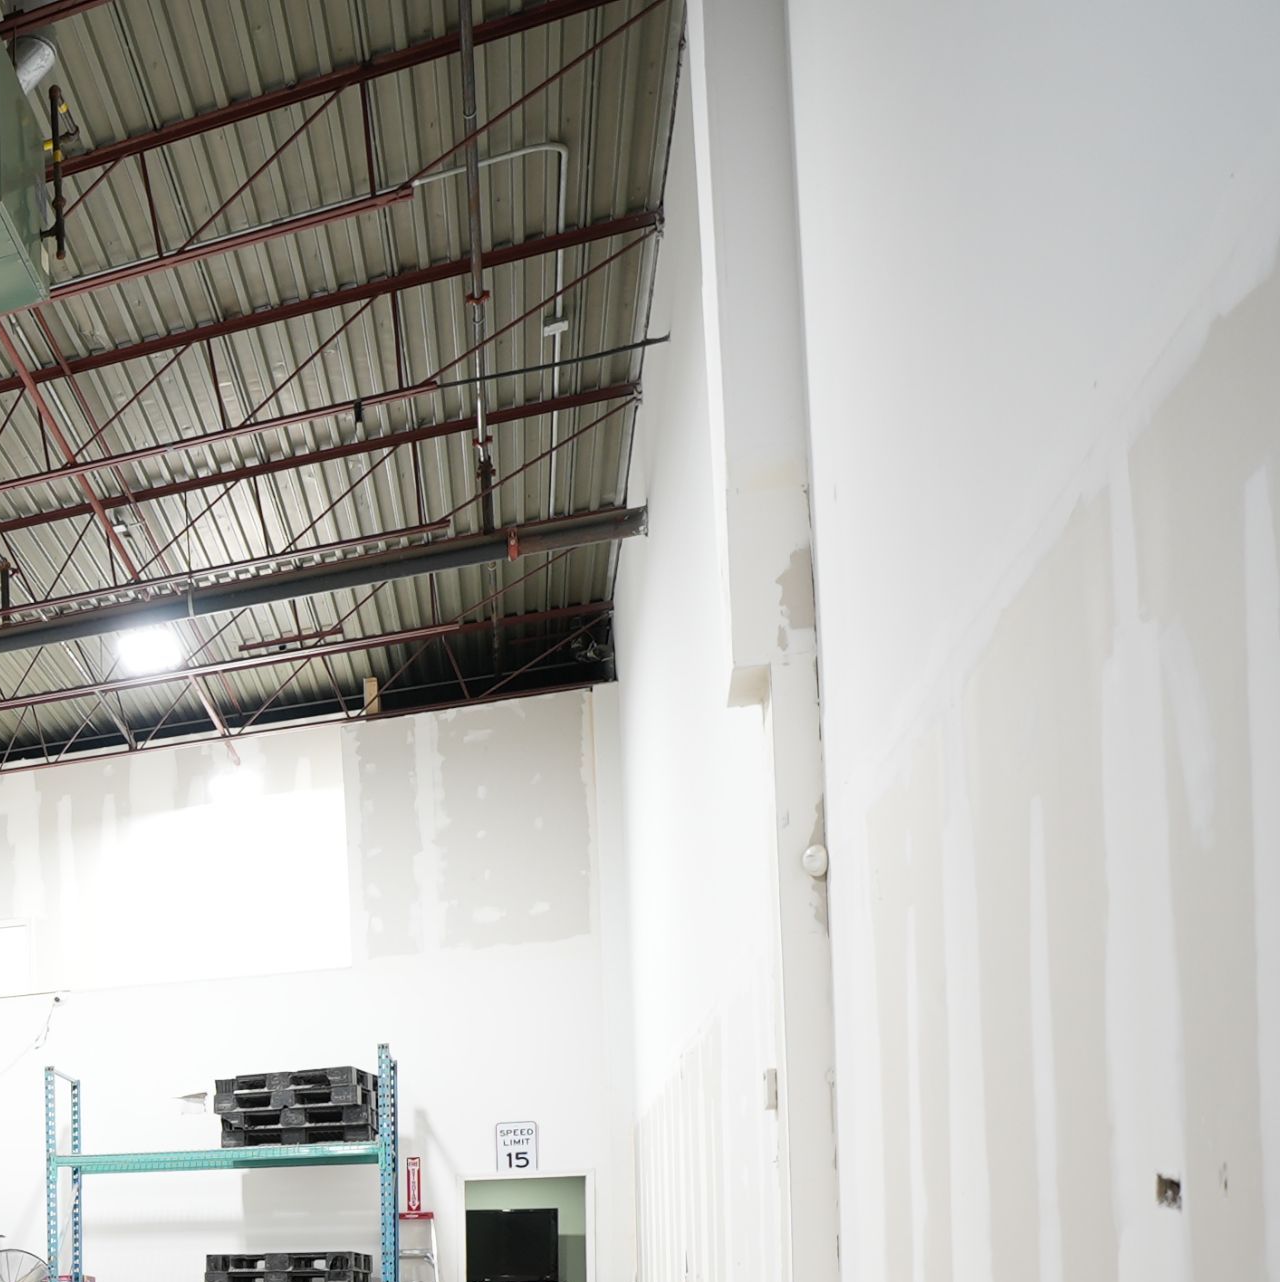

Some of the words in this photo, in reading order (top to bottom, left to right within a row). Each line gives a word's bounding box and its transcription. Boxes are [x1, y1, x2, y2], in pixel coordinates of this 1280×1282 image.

[499, 1128, 534, 1137] SPEED
[503, 1138, 531, 1147] LIMIT
[506, 1151, 530, 1169] 15
